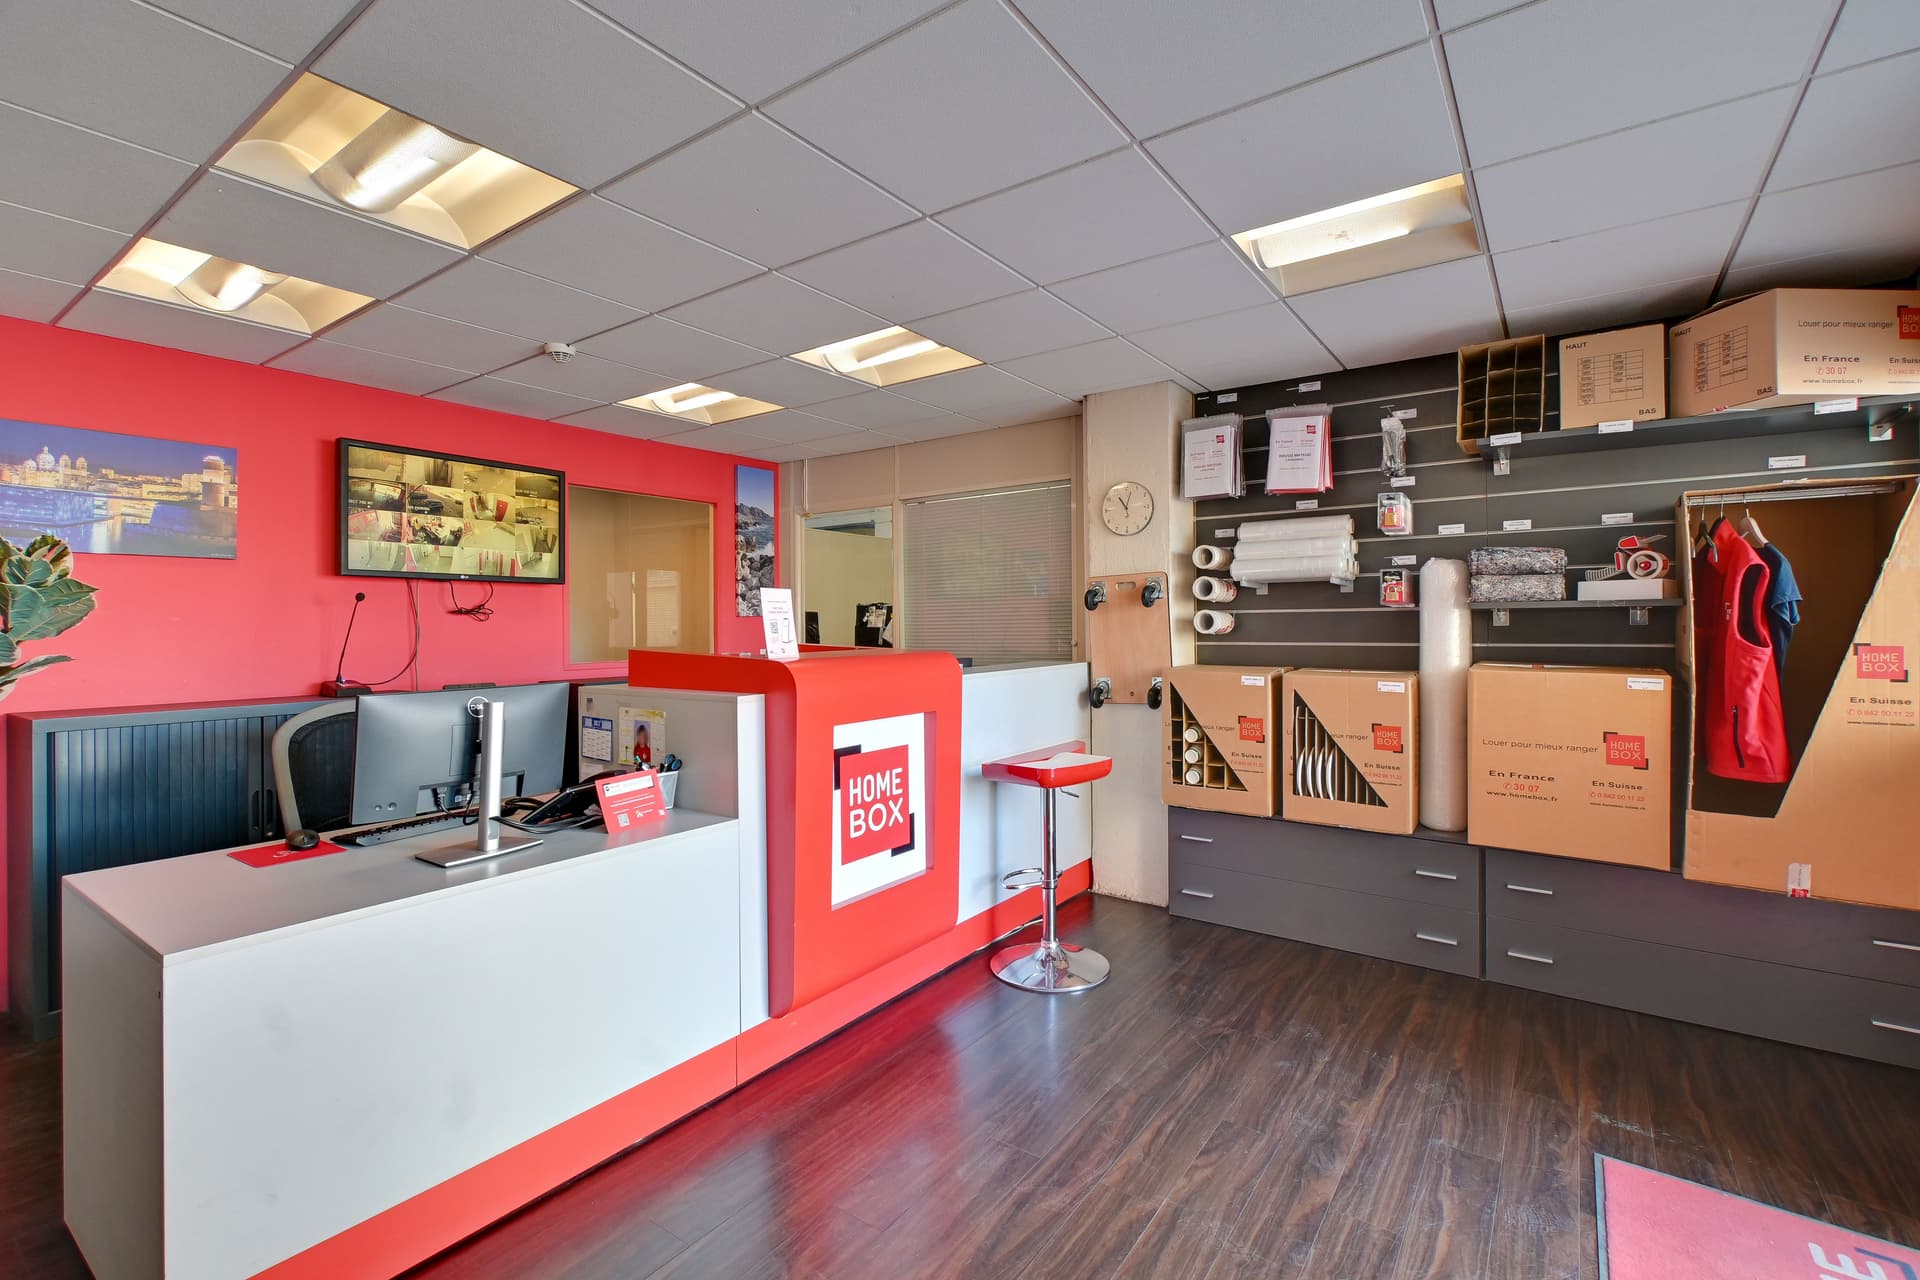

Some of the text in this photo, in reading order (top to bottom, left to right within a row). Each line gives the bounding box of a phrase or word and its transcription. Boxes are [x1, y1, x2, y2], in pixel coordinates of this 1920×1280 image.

[1902, 314, 1920, 323] HOM
[1798, 320, 1820, 328] Louer
[1822, 320, 1841, 329] pour
[1902, 323, 1920, 333] BO
[1565, 341, 1587, 350] HAUT
[1822, 355, 1861, 363] France
[1825, 366, 1847, 375] 30 07
[1756, 385, 1773, 396] BAS
[1638, 407, 1657, 416] BAS
[1862, 652, 1900, 662] HOME
[1862, 662, 1900, 672] BOX
[1850, 696, 1912, 705] En Suisse
[1242, 721, 1261, 730] HOME
[1242, 729, 1261, 737] BOX
[1346, 733, 1368, 741] ranger
[1376, 738, 1399, 746] BOX
[1482, 738, 1599, 754] Louer pour mieux ranger
[1610, 740, 1641, 751] HOME
[1610, 750, 1641, 761] BOX
[1376, 763, 1400, 771] Suisse
[1489, 769, 1556, 782] En France
[849, 767, 903, 807] HOME
[1514, 783, 1540, 793] 30 07
[1608, 781, 1643, 790] Suisse
[1486, 790, 1558, 802] www.homebox.fr
[849, 797, 904, 839] BOX
